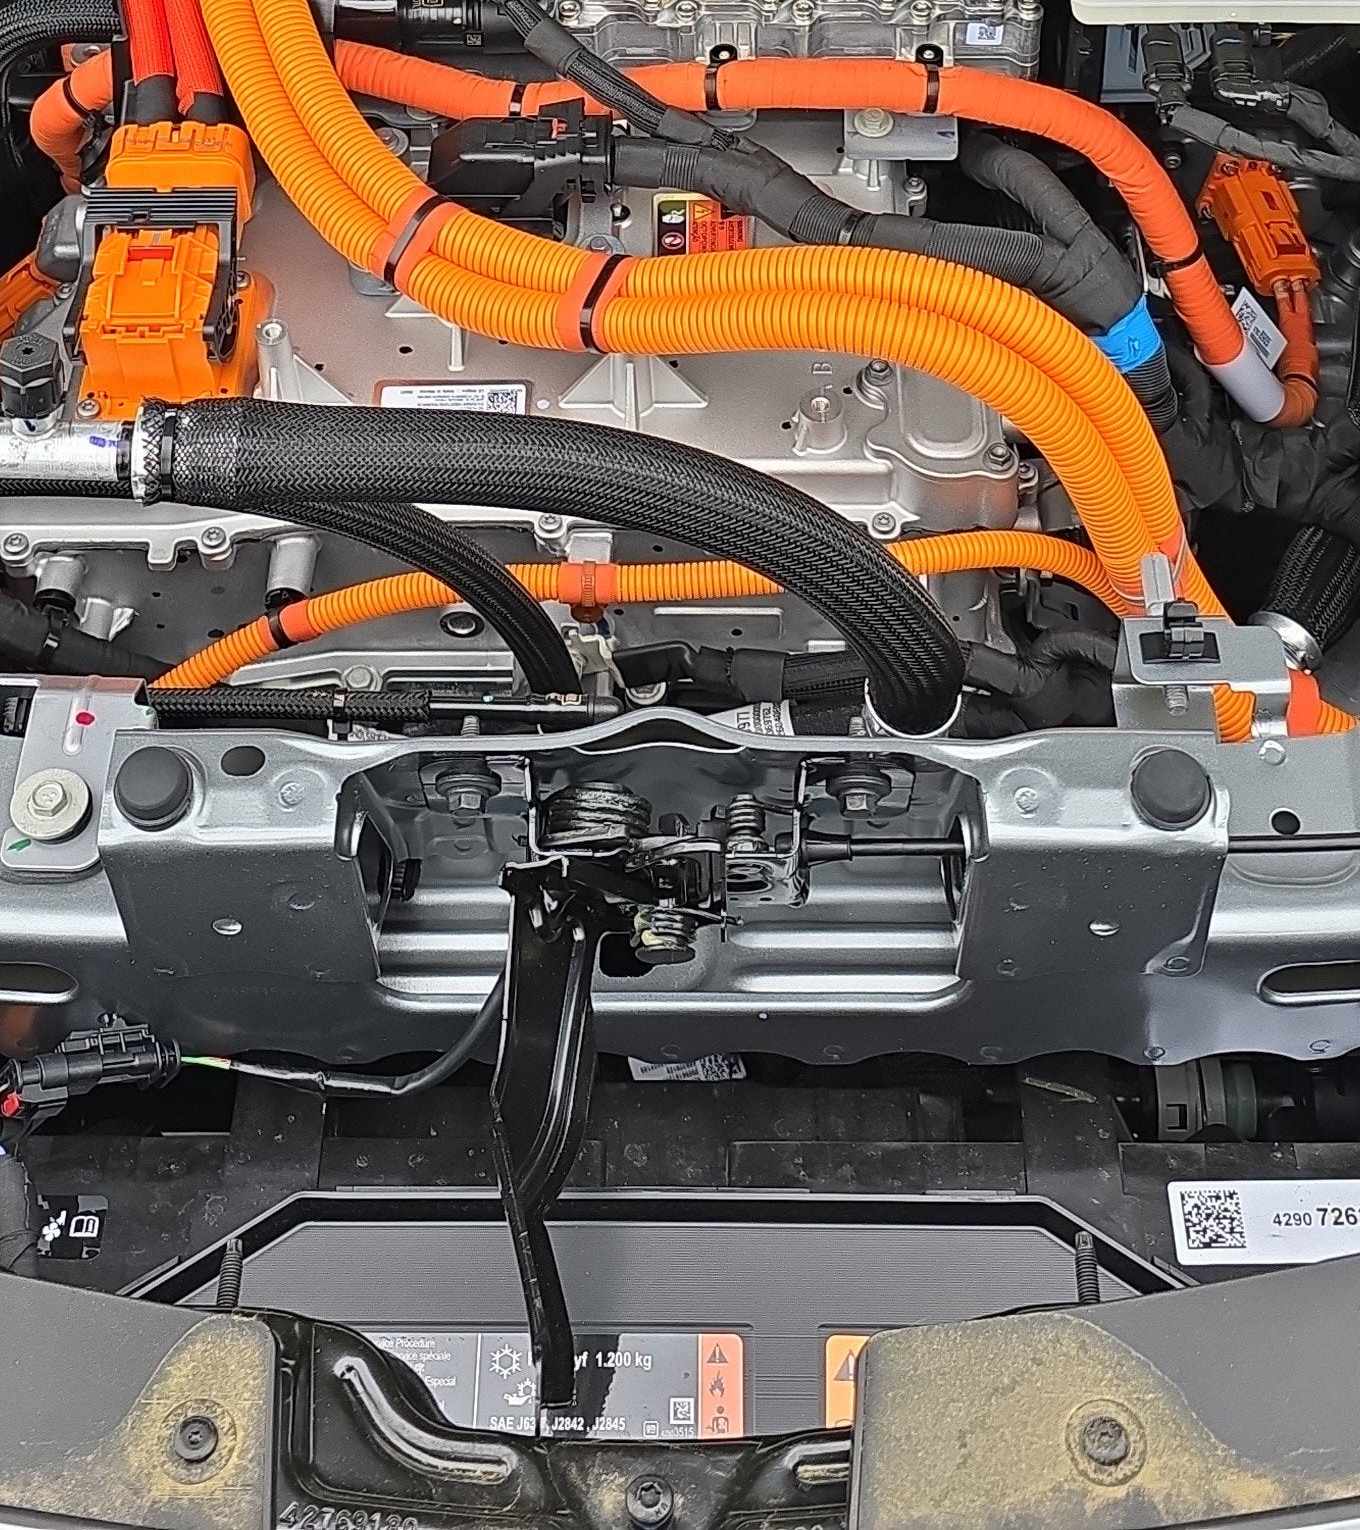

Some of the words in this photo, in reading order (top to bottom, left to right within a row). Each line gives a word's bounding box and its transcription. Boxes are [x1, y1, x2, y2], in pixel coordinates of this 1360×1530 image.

[1273, 1212, 1312, 1227] 4290
[595, 1351, 632, 1368] 1.200
[634, 1351, 652, 1370] kg
[490, 1416, 514, 1431] SAE
[551, 1416, 585, 1431] J2842
[591, 1416, 626, 1431] J2845
